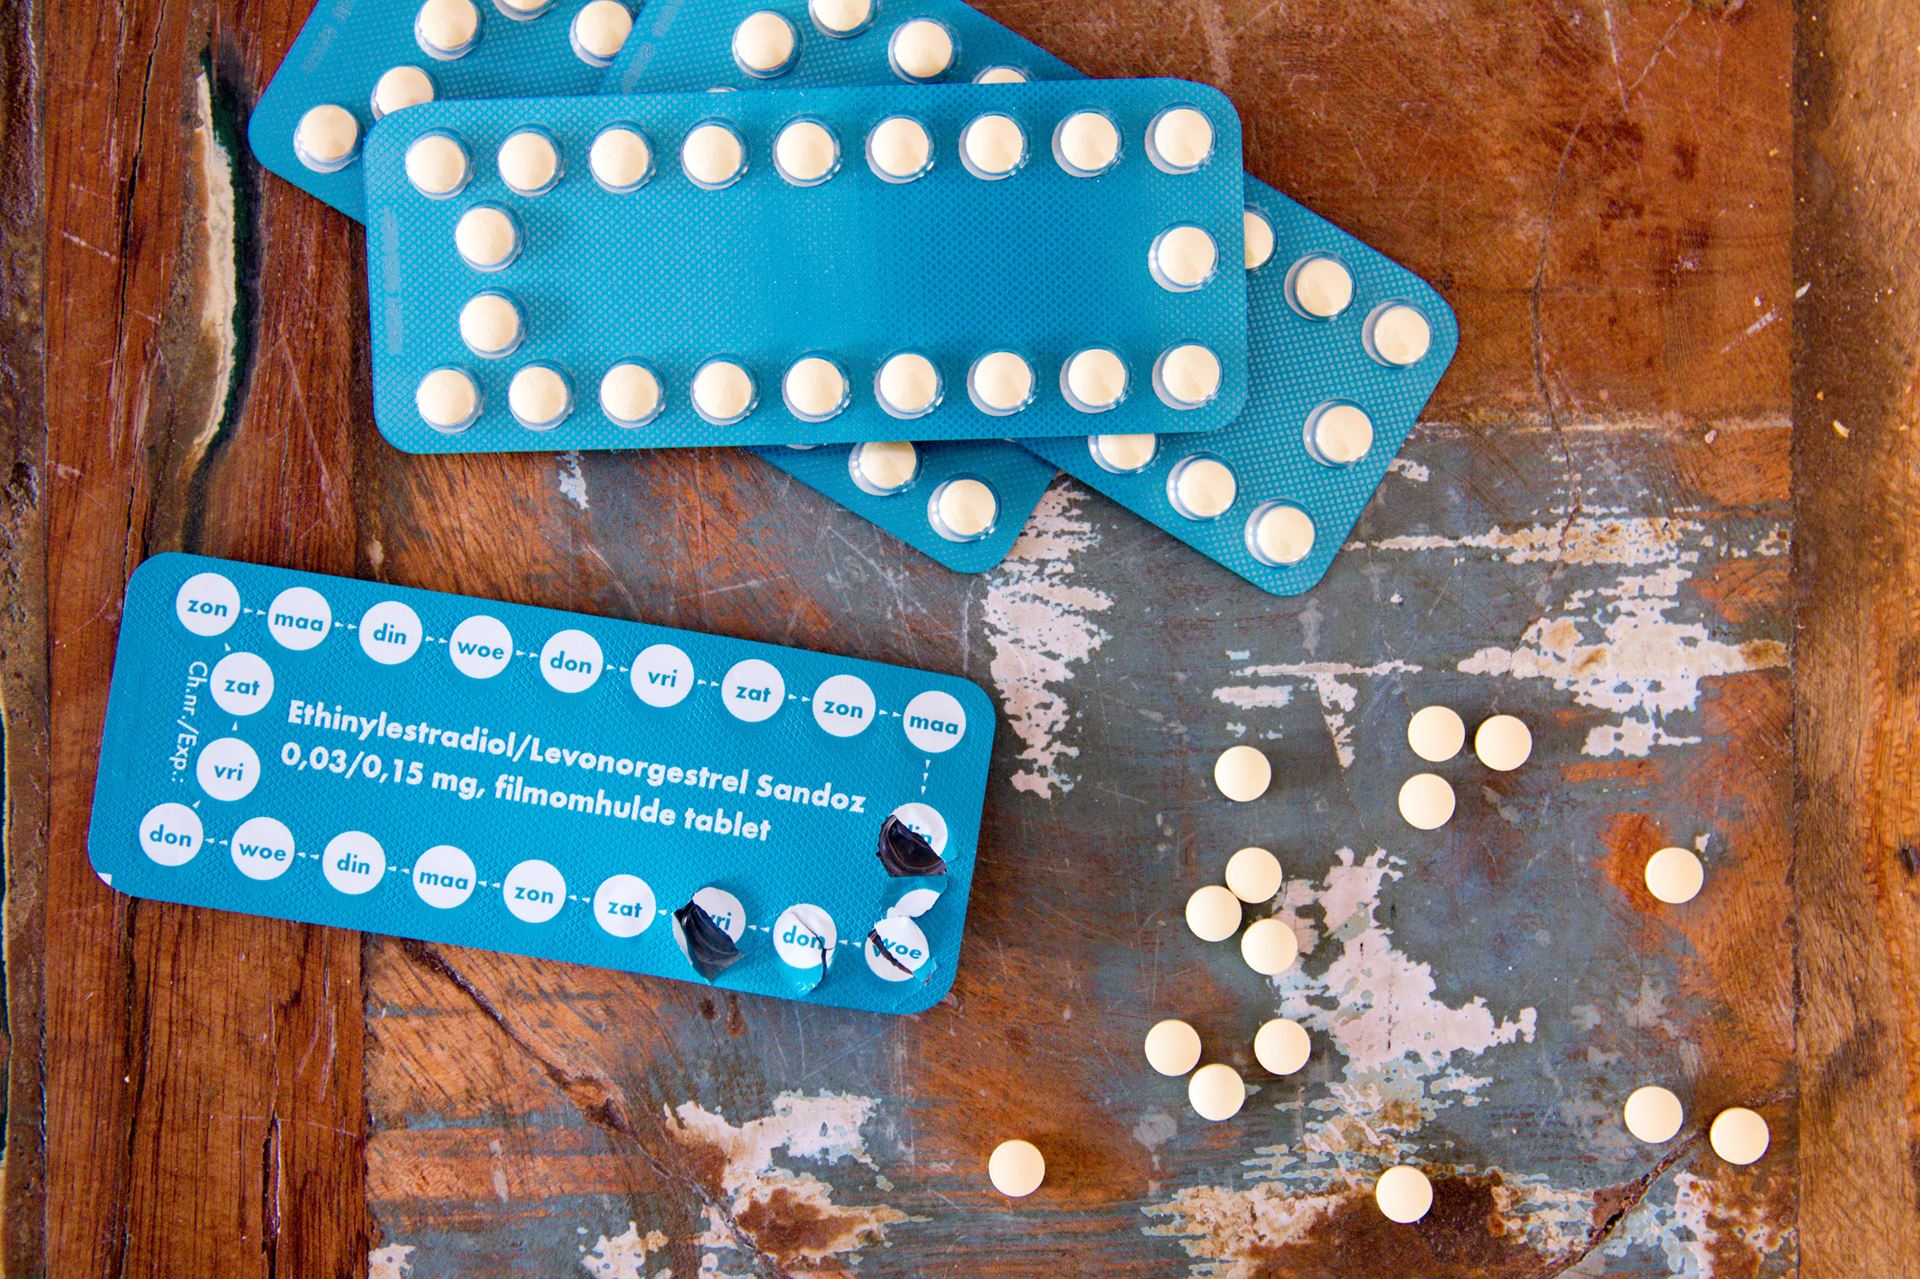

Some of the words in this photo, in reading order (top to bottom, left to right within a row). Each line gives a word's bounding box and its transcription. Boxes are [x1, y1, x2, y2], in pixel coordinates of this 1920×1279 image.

[169, 661, 208, 783] Ch.nr./Exp.:
[187, 599, 228, 618] zon
[274, 613, 324, 632] maa
[372, 622, 407, 646] din
[457, 641, 505, 661] woe
[549, 649, 593, 675] don
[647, 668, 678, 688] vri
[735, 685, 772, 703] zat
[822, 700, 864, 719] zon
[909, 715, 959, 736] maa
[224, 679, 261, 697] zat
[213, 762, 244, 782] vri
[280, 741, 424, 785] 0,03/0,15
[431, 771, 485, 800] mg,
[495, 773, 677, 827] filmomhulde
[684, 807, 772, 842] tablet
[287, 699, 749, 794] Ethinylestradiol/Levonorgestrel
[755, 774, 867, 814] Sandoz
[149, 823, 193, 848] don
[239, 843, 287, 862] woe
[336, 852, 371, 875] din
[419, 871, 469, 891] maa
[514, 886, 554, 905] zon
[607, 901, 643, 919] zat
[710, 911, 731, 931] ri
[782, 924, 826, 950] don
